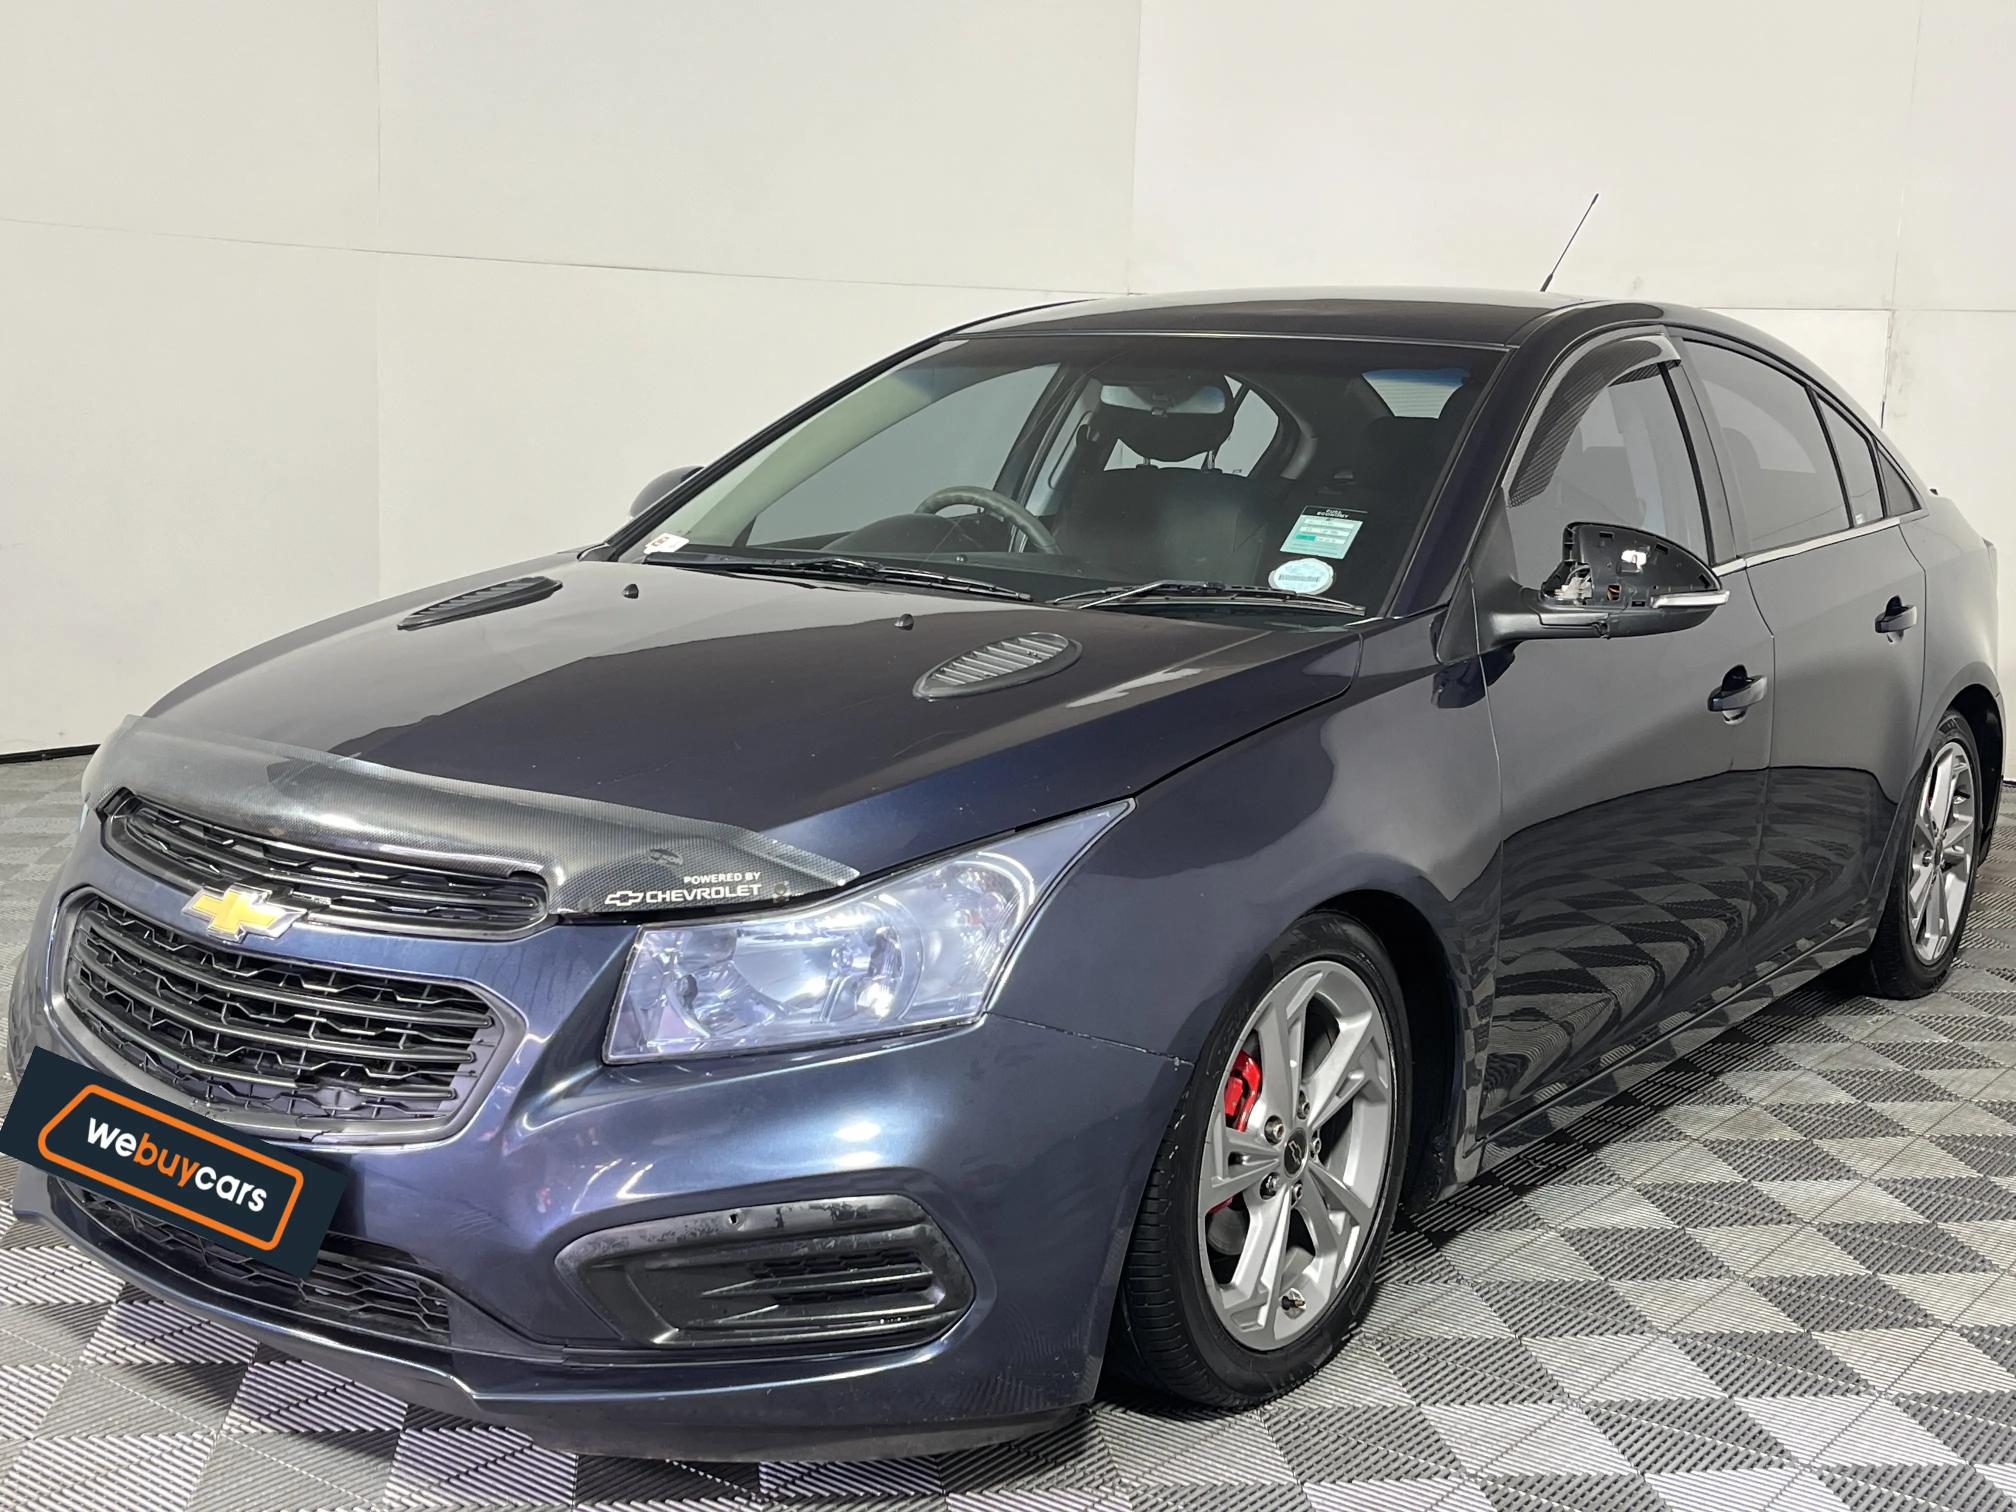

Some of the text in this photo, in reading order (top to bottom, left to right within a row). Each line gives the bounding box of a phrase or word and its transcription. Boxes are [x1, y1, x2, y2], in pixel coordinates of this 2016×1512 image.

[683, 872, 761, 884] POWERED BY
[645, 884, 762, 904] CHEVROLET
